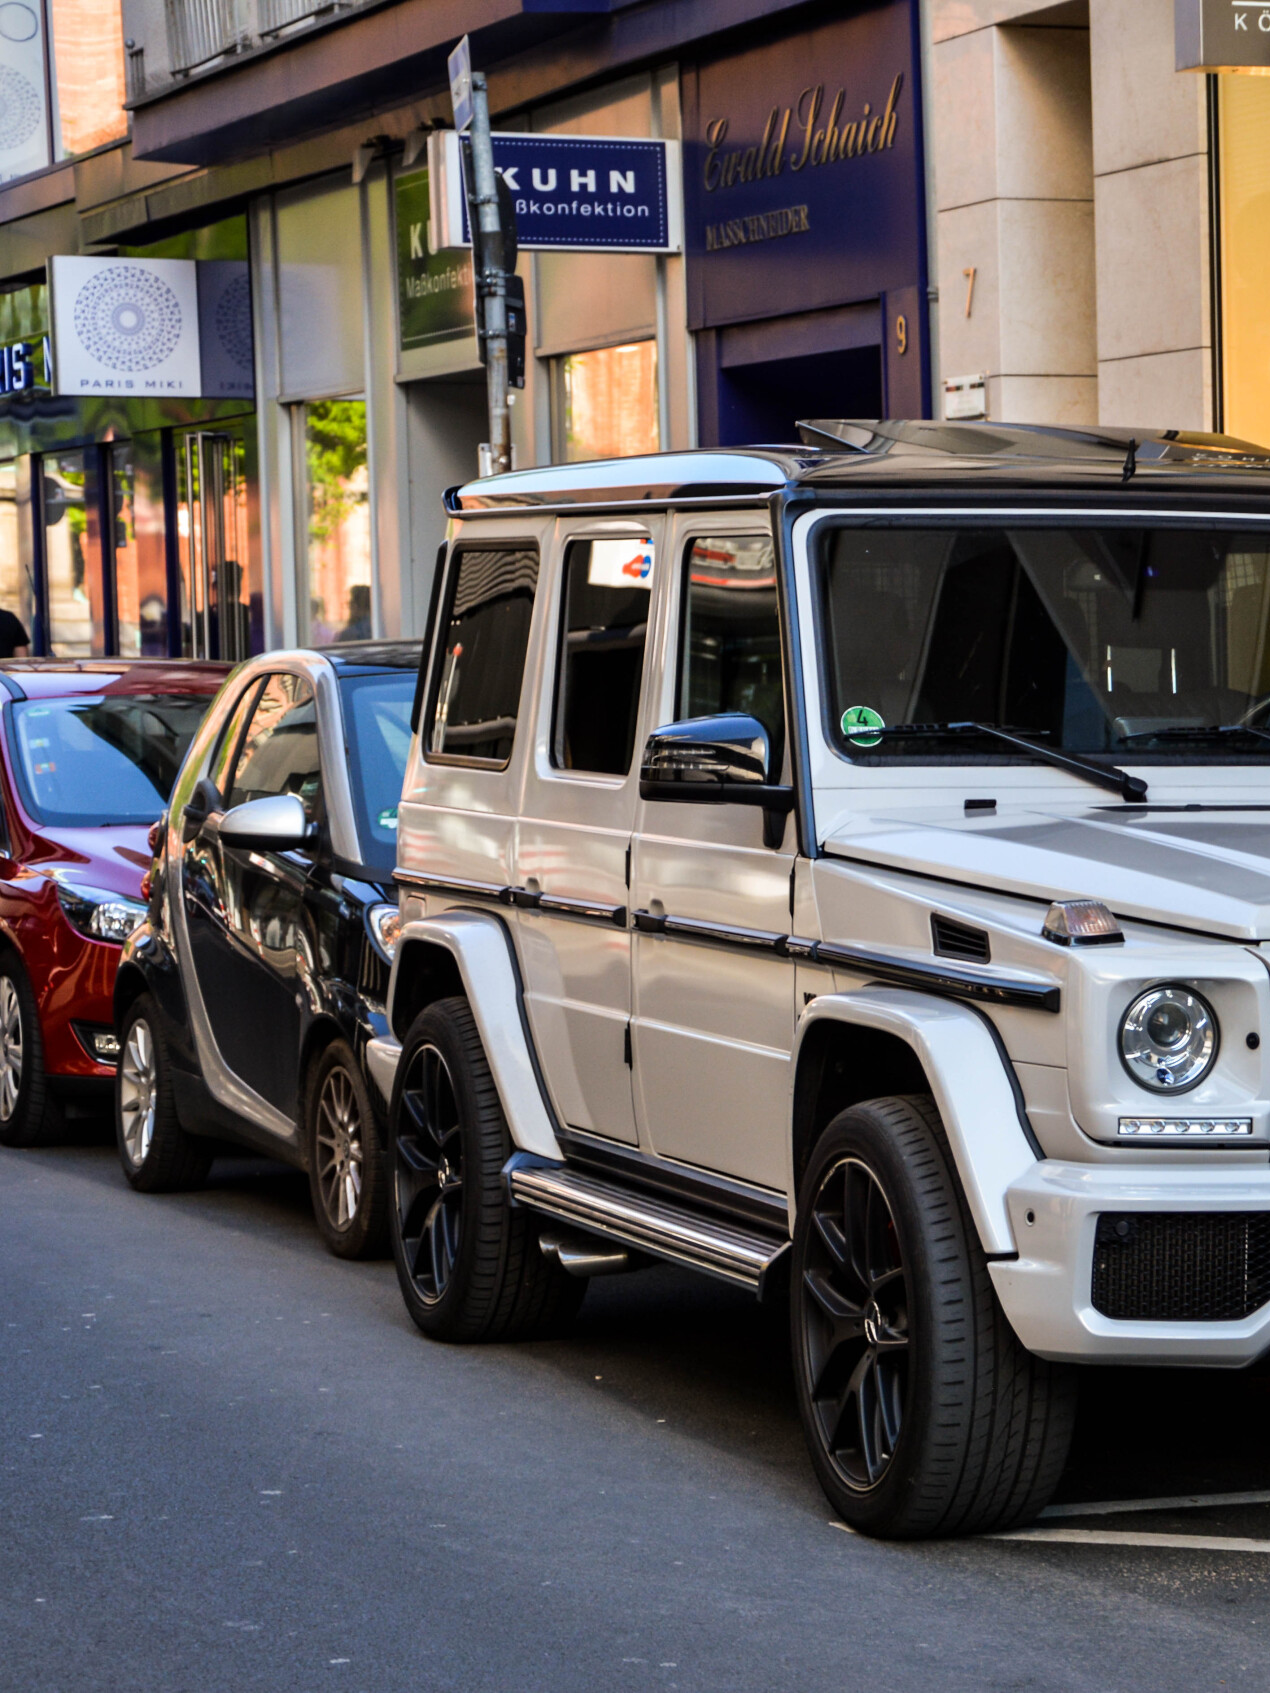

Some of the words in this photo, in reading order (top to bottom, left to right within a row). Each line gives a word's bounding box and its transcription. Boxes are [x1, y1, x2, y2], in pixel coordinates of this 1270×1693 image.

[704, 105, 791, 192] Ewald
[789, 72, 903, 171] Schaich
[494, 167, 636, 193] KUHN
[705, 204, 810, 251] MASSCHNEIDER
[963, 267, 976, 319] 7
[896, 315, 907, 354] 9
[80, 379, 134, 389] PARIS
[145, 379, 183, 389] MIKI
[856, 709, 869, 727] 4
